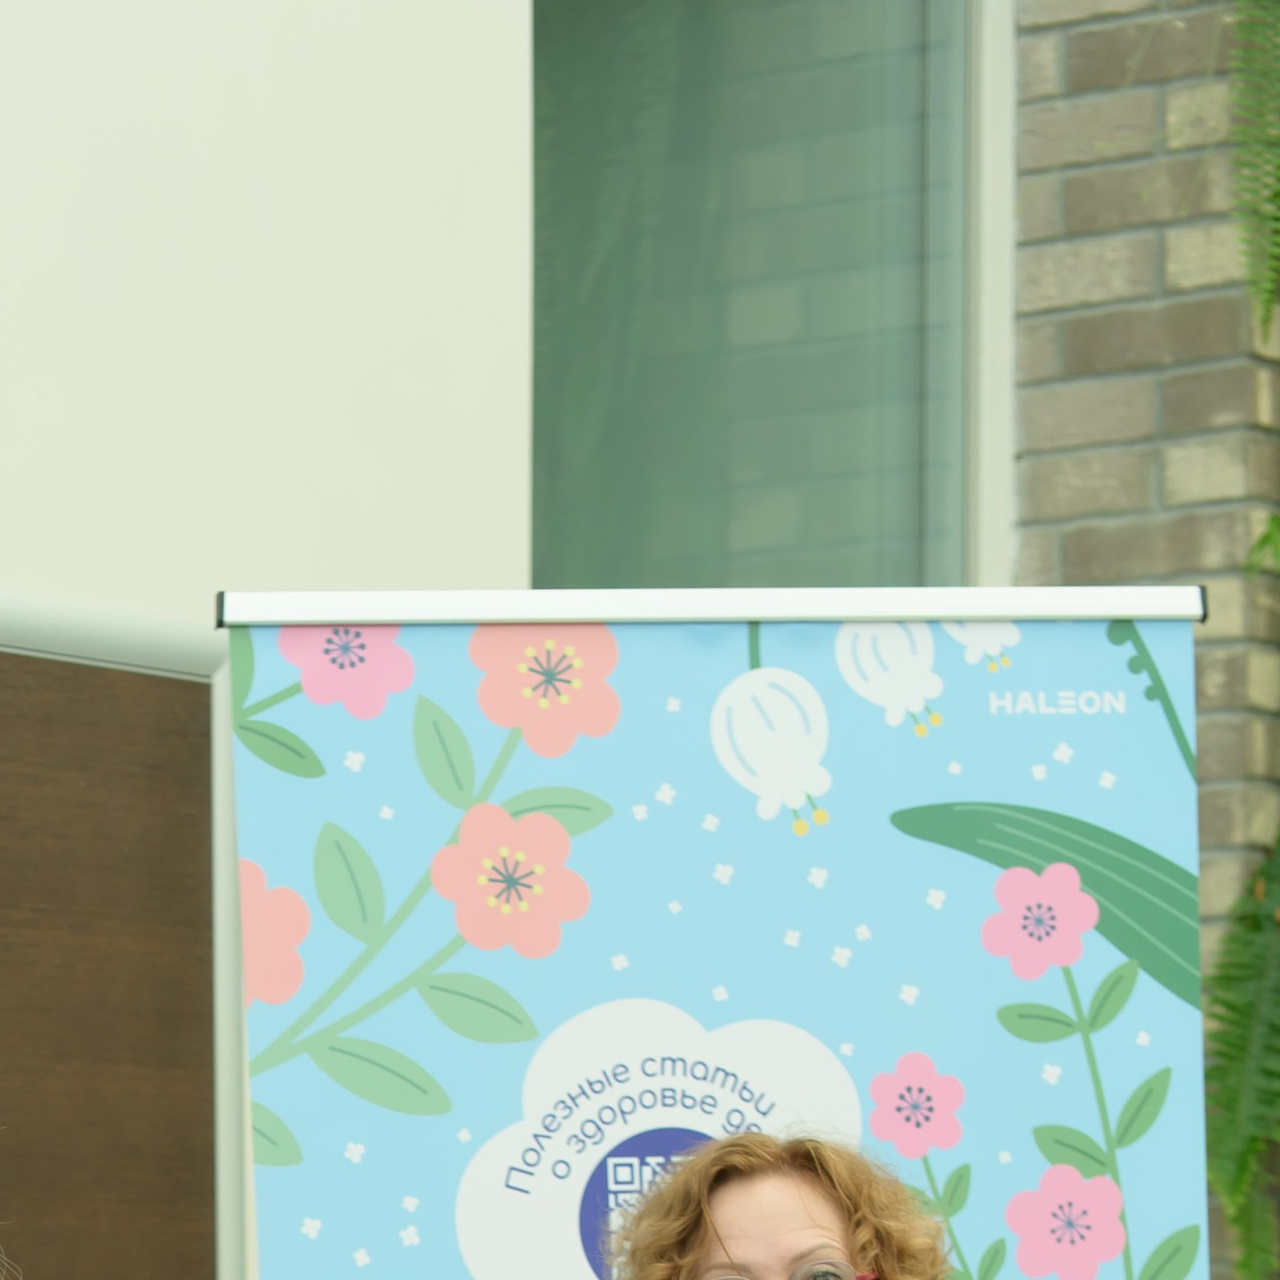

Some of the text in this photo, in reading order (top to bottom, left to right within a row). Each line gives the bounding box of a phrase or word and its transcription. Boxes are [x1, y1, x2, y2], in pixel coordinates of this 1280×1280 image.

[988, 690, 1127, 715] HALEON
[504, 1055, 776, 1195] Полезные статьи
[551, 1158, 572, 1180] о
[567, 1087, 719, 1155] здоровье
